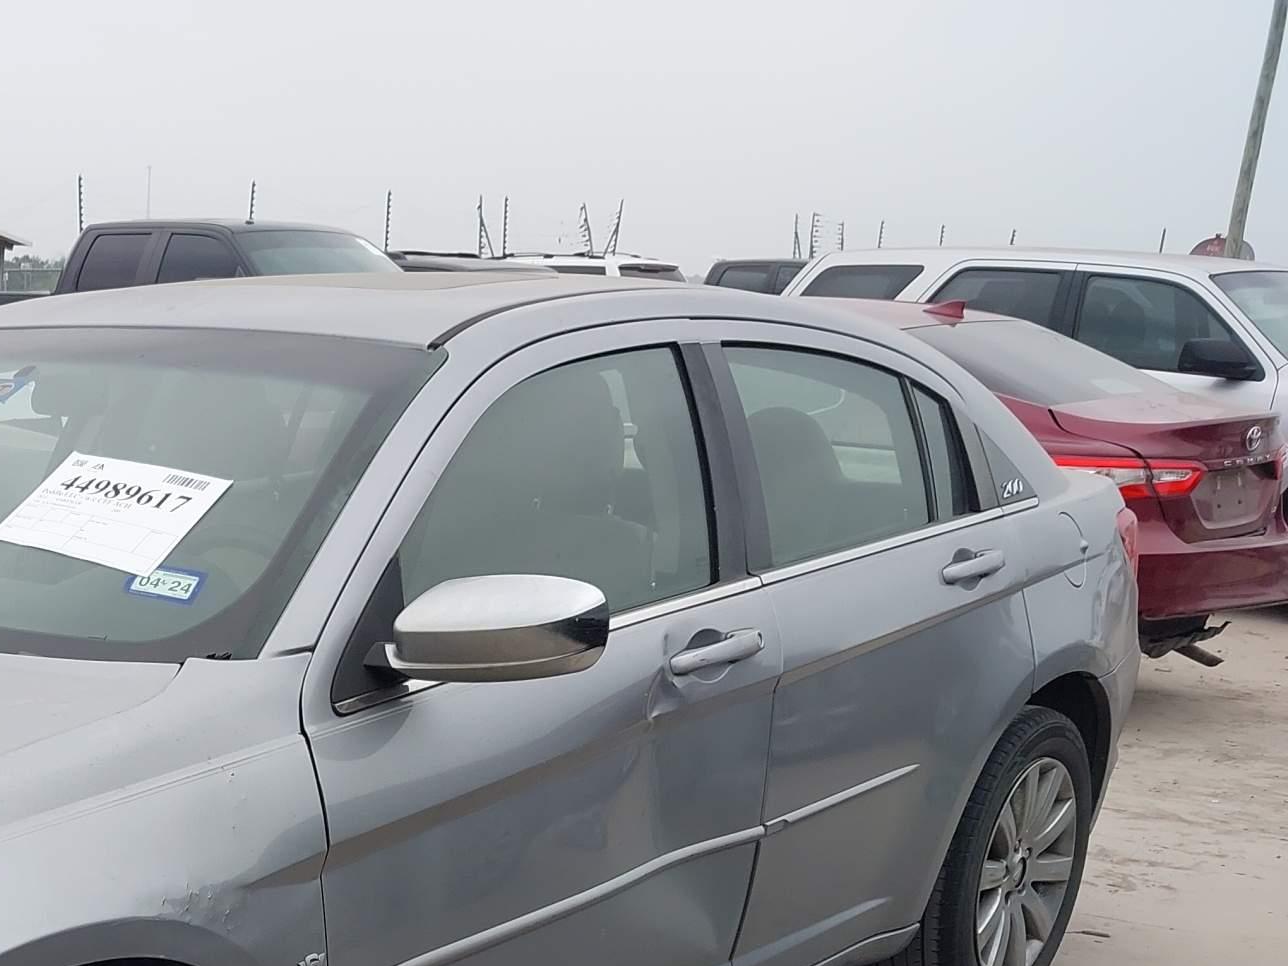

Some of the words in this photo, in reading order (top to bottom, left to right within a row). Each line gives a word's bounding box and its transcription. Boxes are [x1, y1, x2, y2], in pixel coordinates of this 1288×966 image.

[60, 475, 193, 513] 44989617
[138, 576, 161, 589] 04
[167, 580, 192, 594] 24
